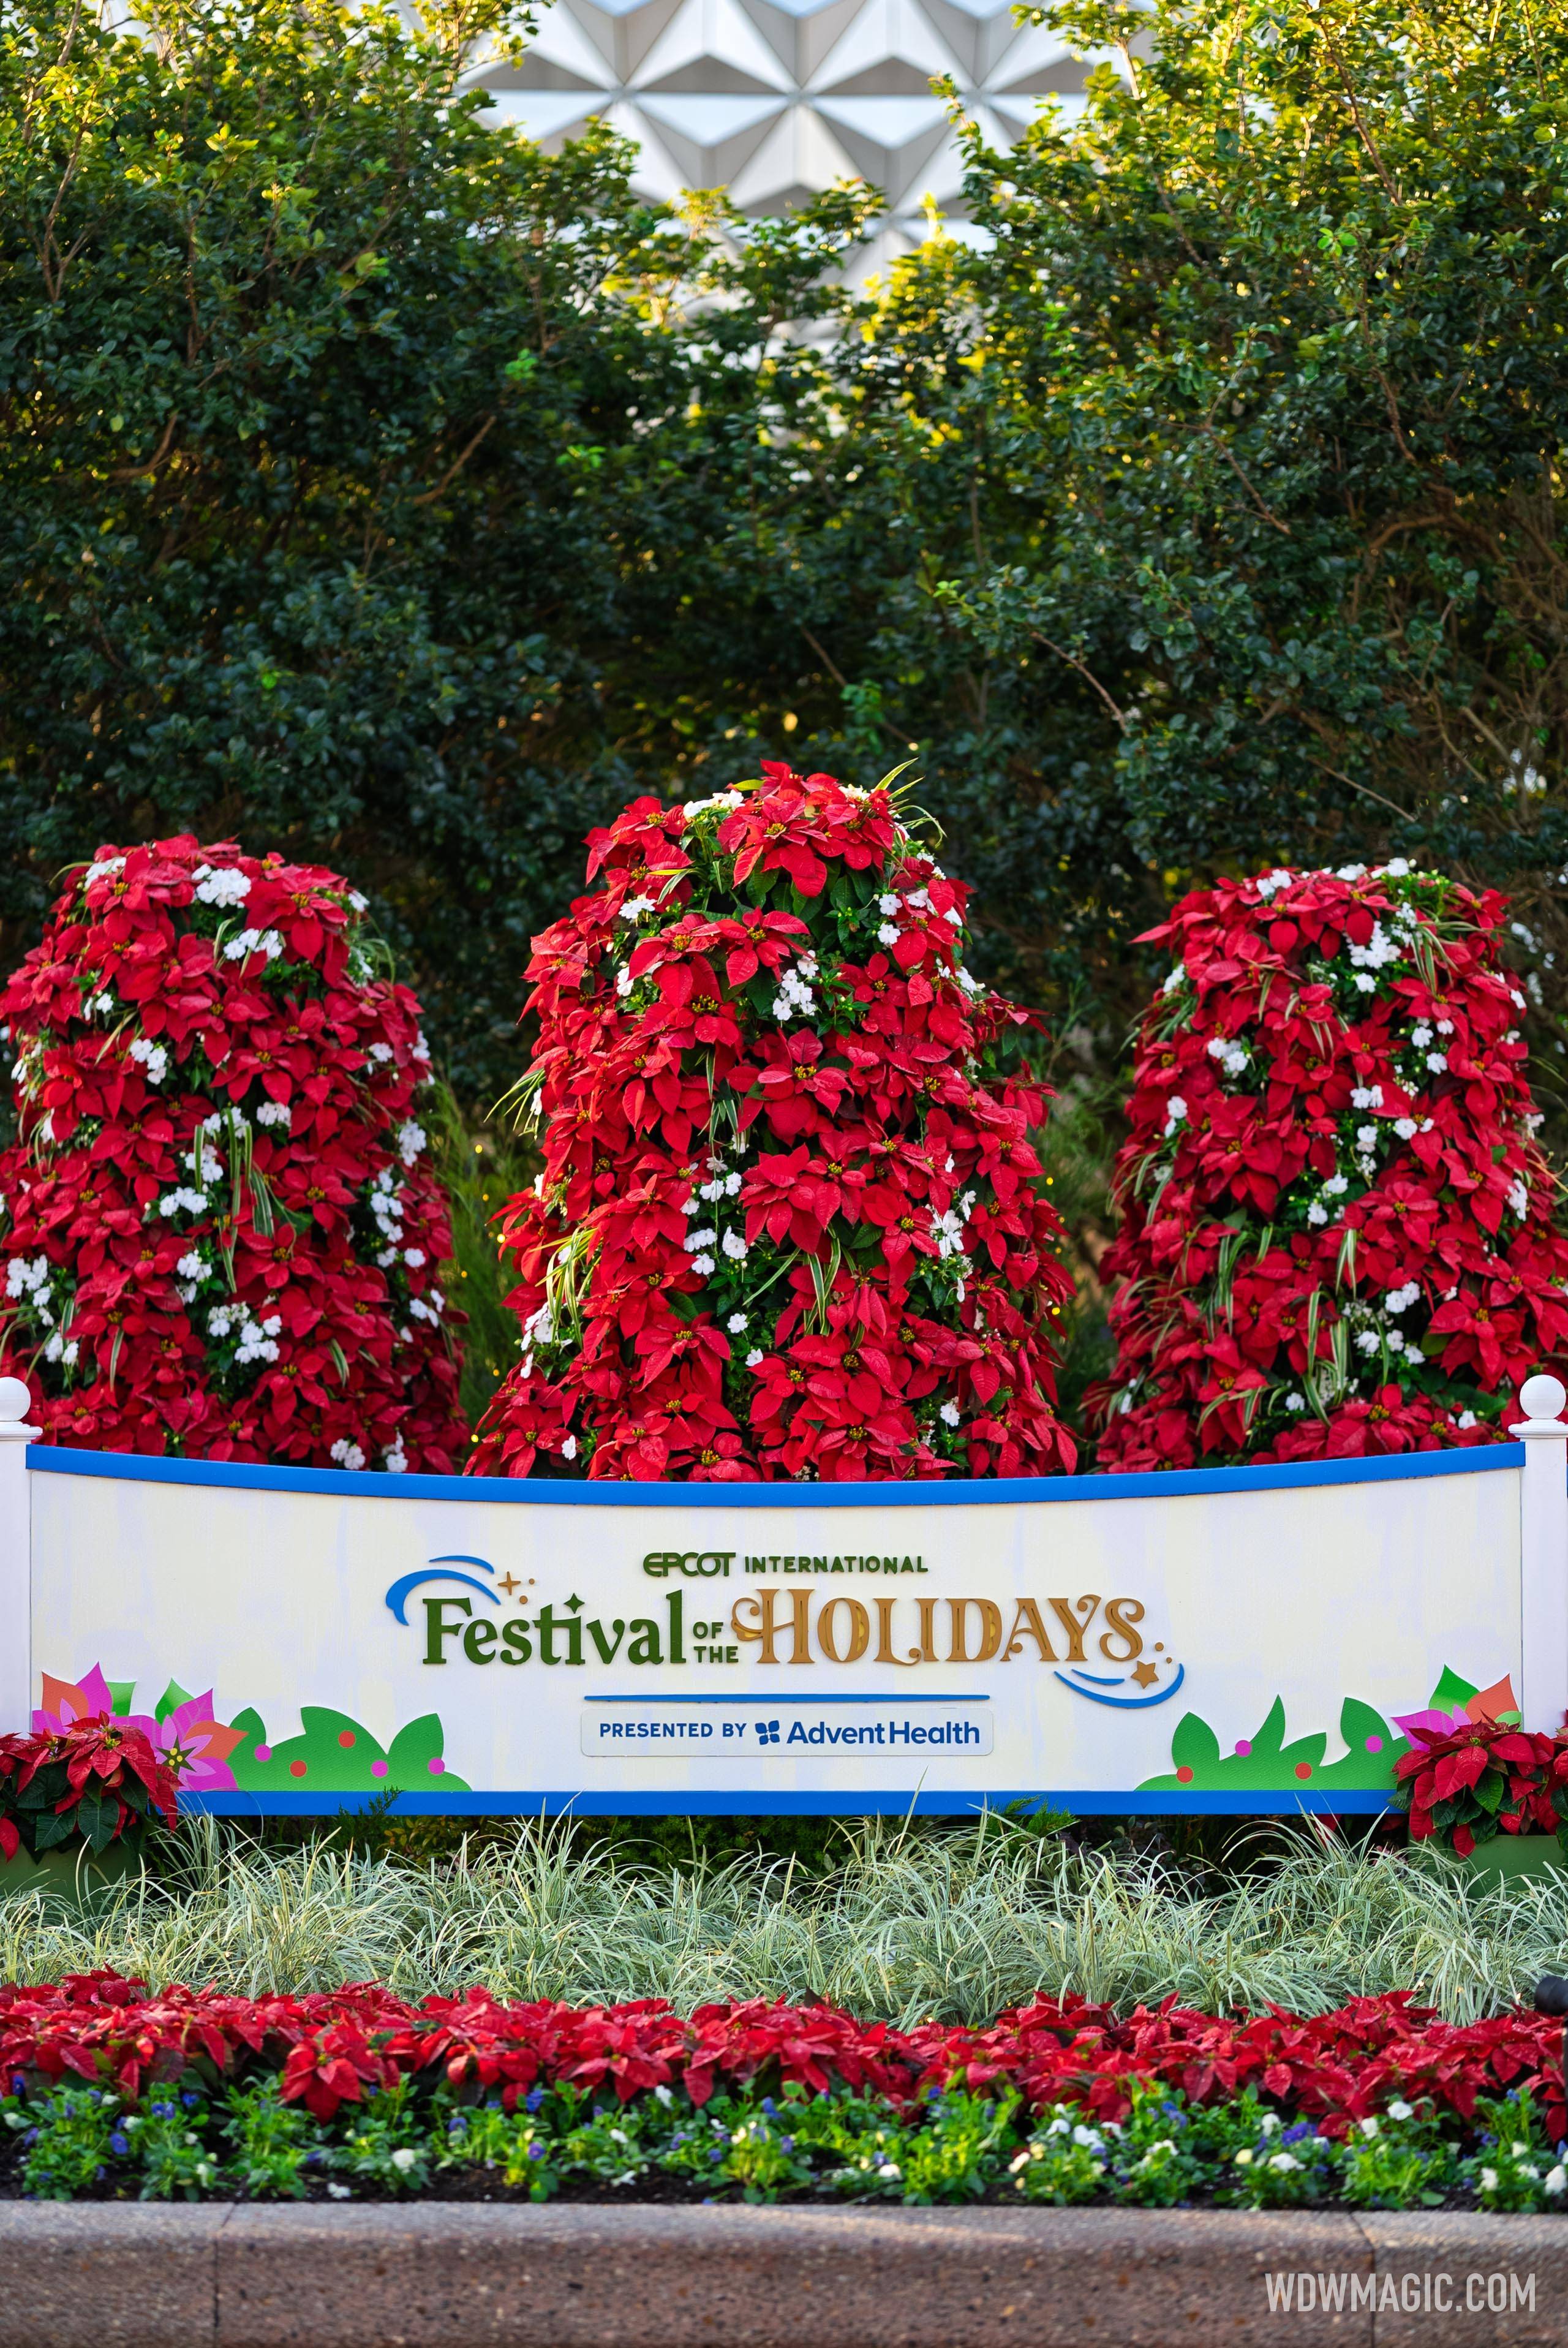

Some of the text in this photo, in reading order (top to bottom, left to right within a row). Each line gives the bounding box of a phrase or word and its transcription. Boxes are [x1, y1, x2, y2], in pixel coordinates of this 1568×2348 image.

[643, 1552, 929, 1577] EPCOT INTERNATIONAL
[422, 1588, 1145, 1666] Festival OF THE HOLIDAYS
[600, 1720, 980, 1745] PRESENTED BY AdventHealth
